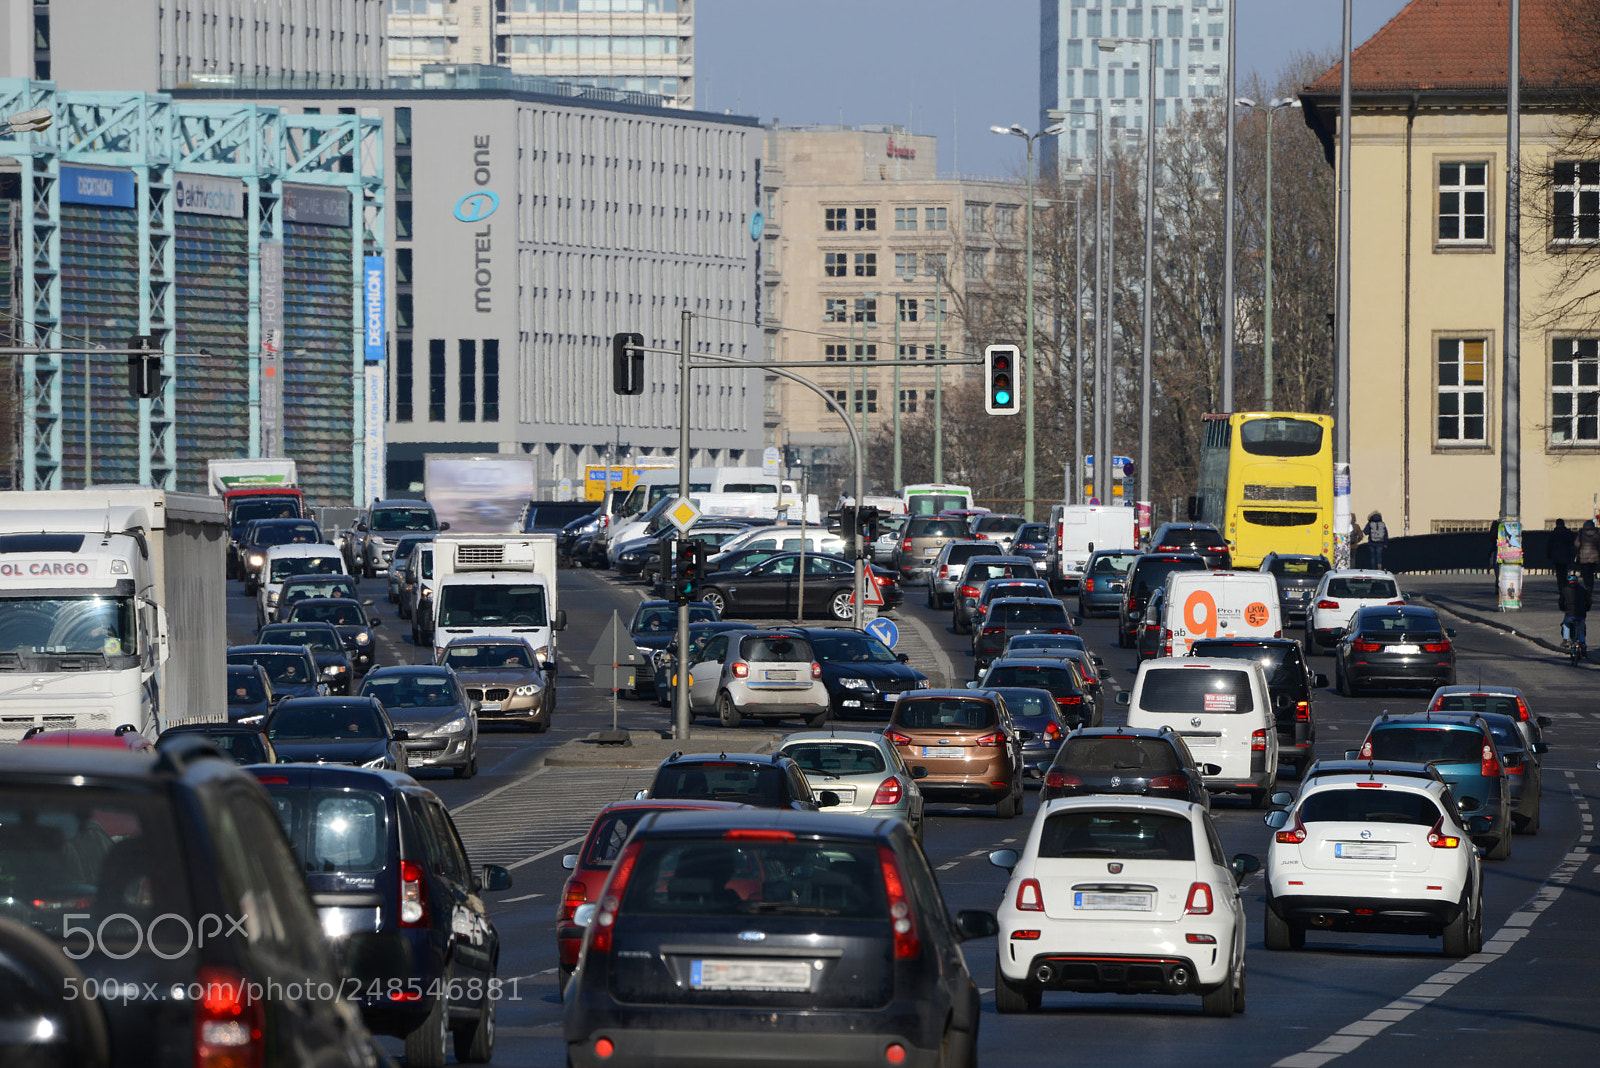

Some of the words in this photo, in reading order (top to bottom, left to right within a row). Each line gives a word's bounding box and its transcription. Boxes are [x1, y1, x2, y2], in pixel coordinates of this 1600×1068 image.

[78, 176, 114, 197] DECATHLON
[265, 273, 276, 322] HOME
[368, 270, 381, 346] DECATHLON
[29, 563, 89, 576] CARGO
[1247, 605, 1266, 614] LKW
[1174, 628, 1186, 637] ab
